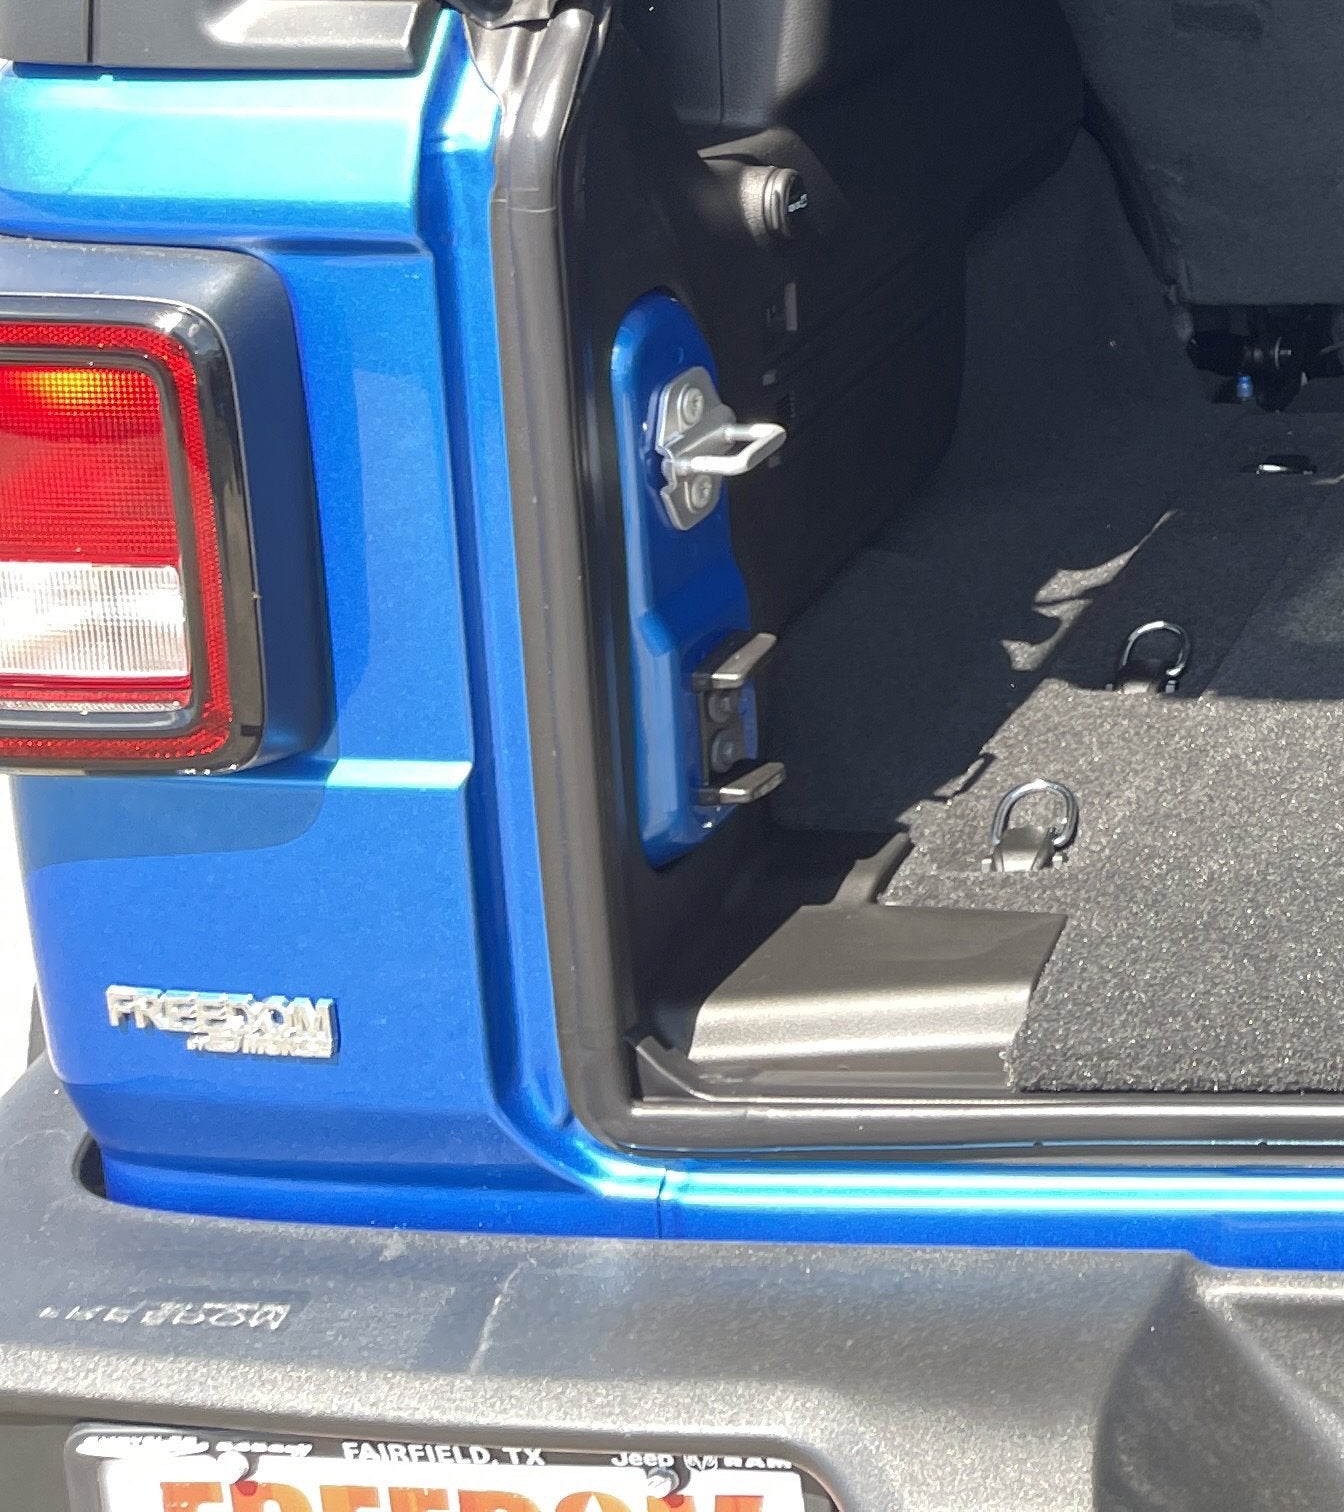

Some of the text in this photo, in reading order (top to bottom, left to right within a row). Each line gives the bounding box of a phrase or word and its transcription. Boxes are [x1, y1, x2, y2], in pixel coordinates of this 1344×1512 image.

[106, 985, 336, 1039] FREEDOM
[502, 1446, 545, 1466] TX
[611, 1451, 675, 1468] Jeep
